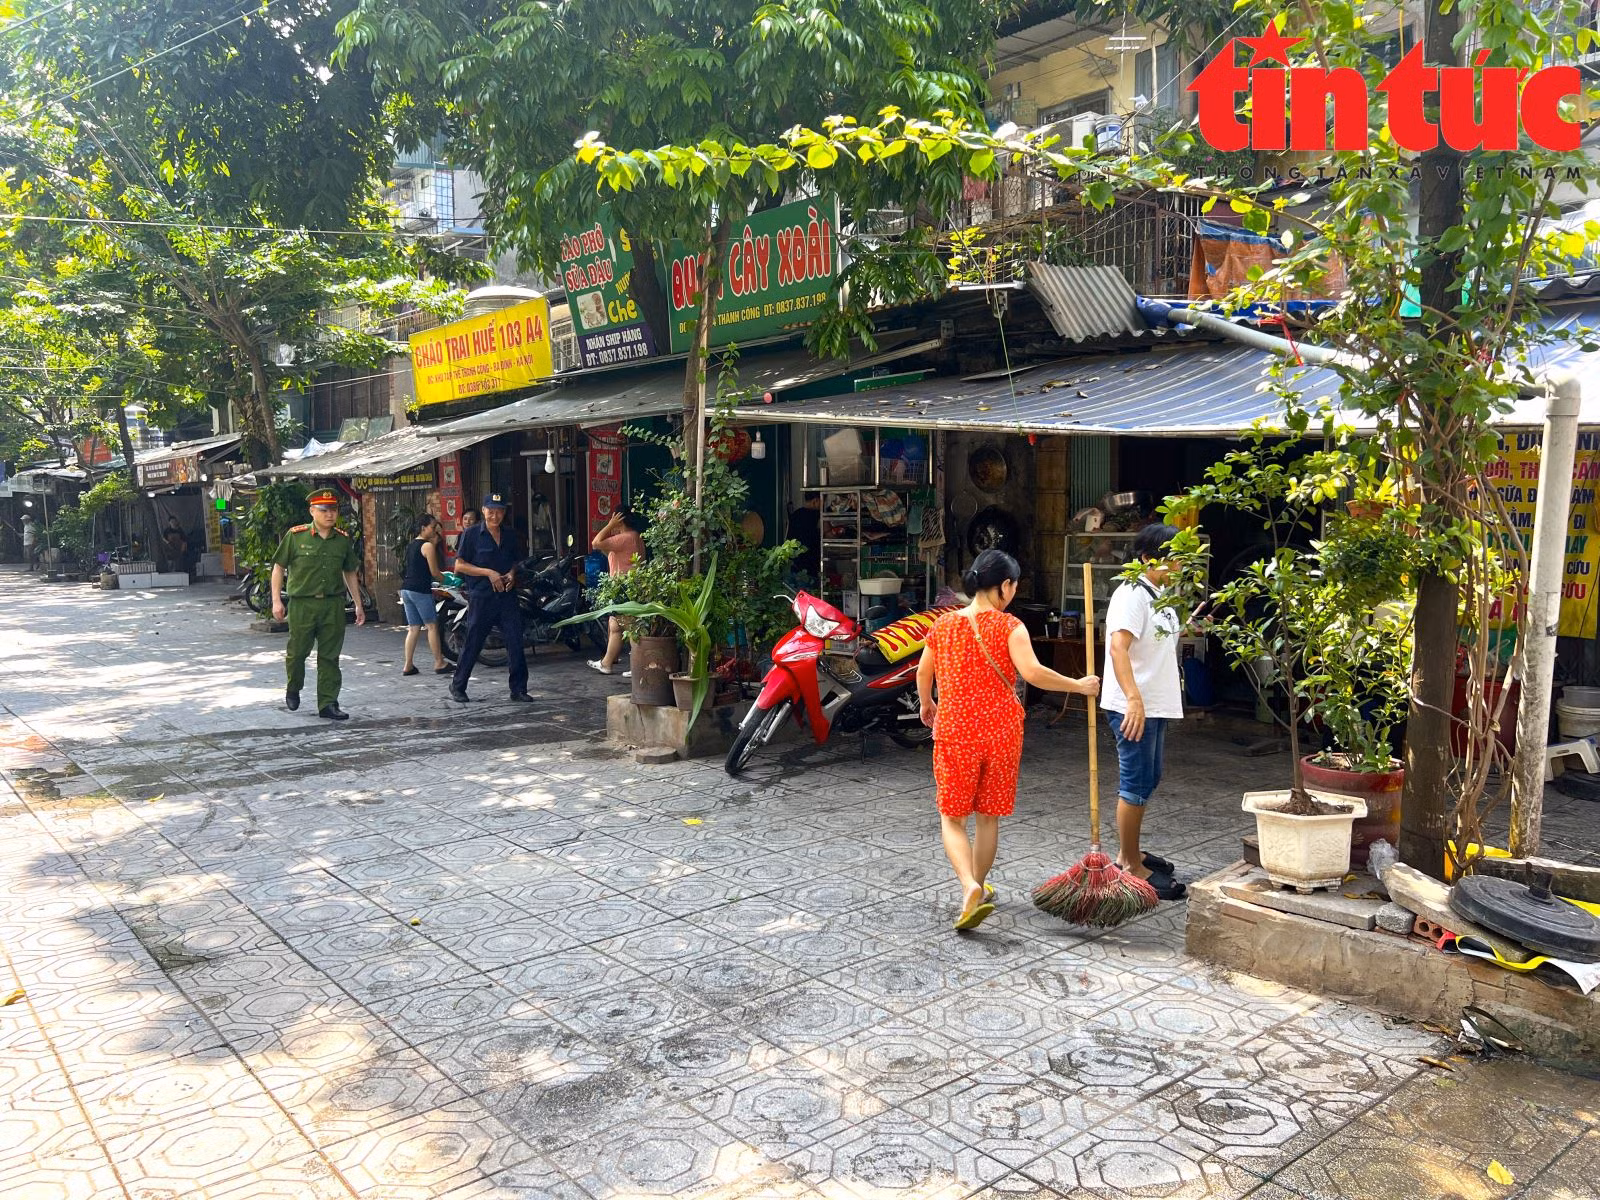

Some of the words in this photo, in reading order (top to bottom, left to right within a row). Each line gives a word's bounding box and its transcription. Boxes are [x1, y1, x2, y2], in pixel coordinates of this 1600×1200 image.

[728, 224, 771, 298] CÂY
[777, 205, 832, 288] XOÀI
[565, 262, 589, 292] SỮA
[587, 255, 613, 290] ĐẬU
[608, 294, 638, 323] Chè
[717, 310, 740, 326] THÀNH
[741, 305, 761, 321] CÔNG
[764, 305, 775, 317] ĐT:
[415, 338, 443, 369] CHÁO
[445, 333, 470, 362] TRAI
[472, 318, 497, 356] HUẾ
[499, 319, 522, 350] 103
[526, 314, 543, 344] A4
[585, 333, 606, 351] NHẬN
[605, 331, 621, 345] SHIP
[622, 327, 642, 343] HÀNG
[586, 353, 598, 367] ĐT:
[598, 342, 648, 363] 0837.837.198
[1567, 559, 1590, 575] CỨU
